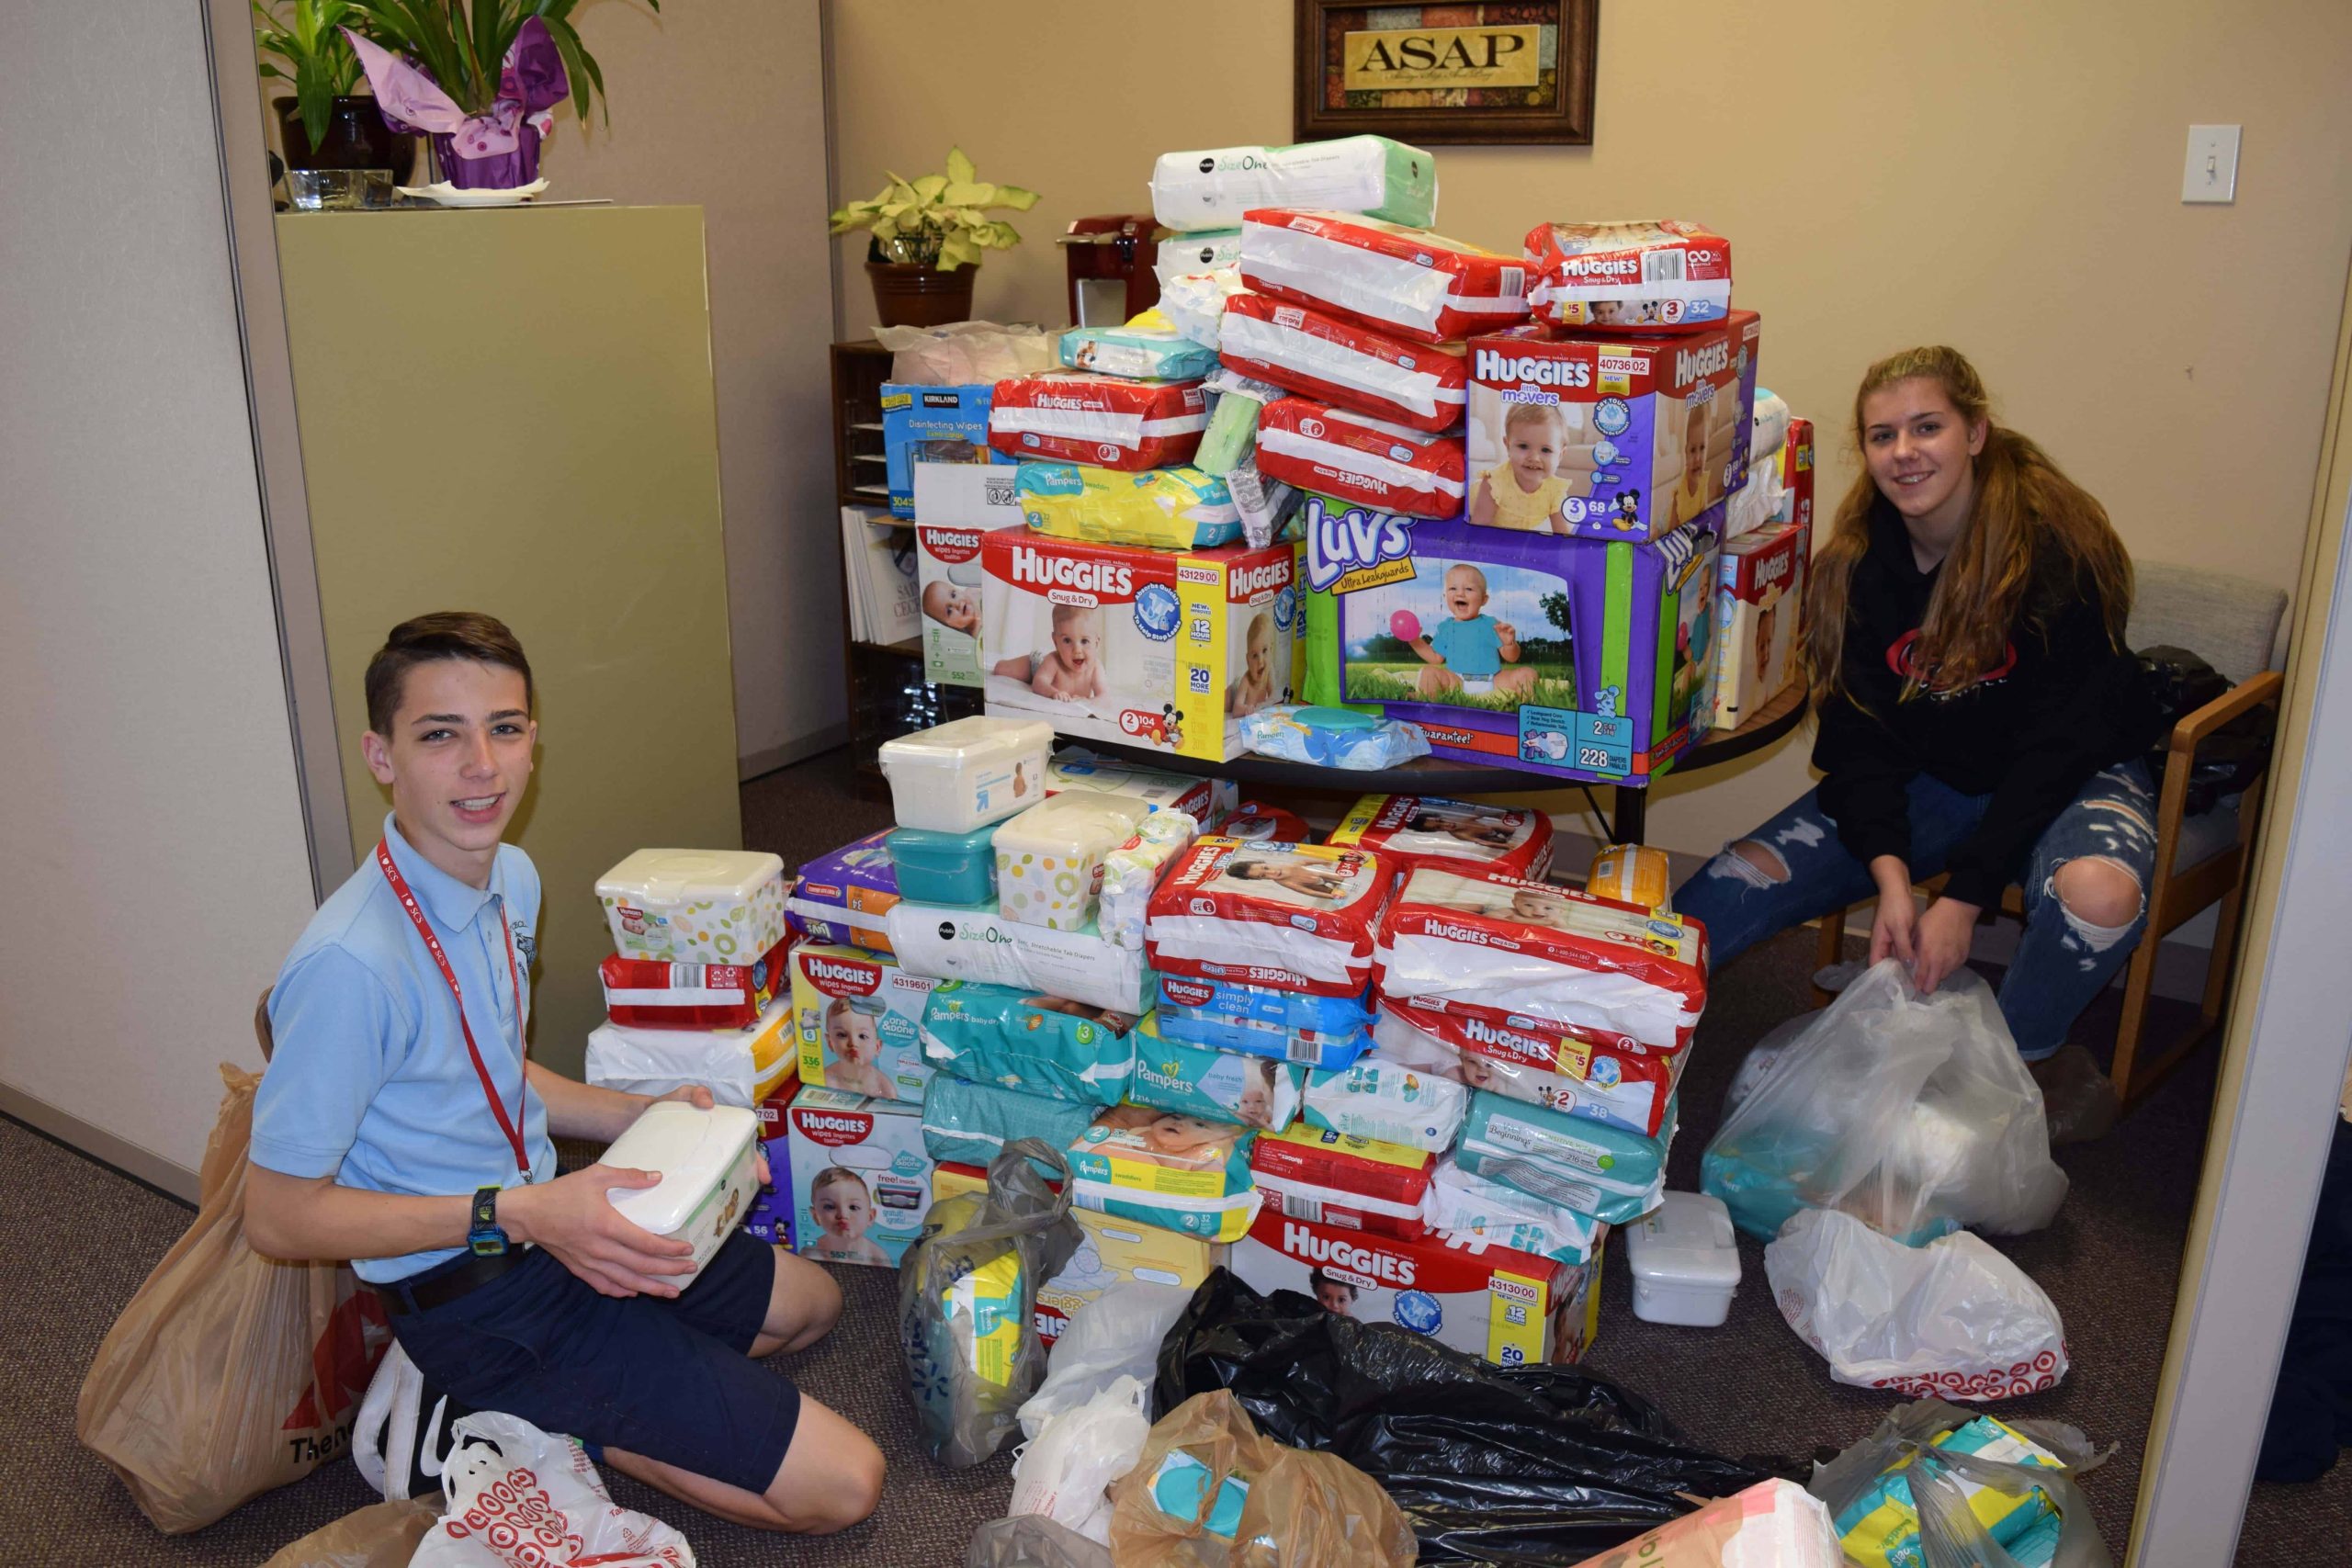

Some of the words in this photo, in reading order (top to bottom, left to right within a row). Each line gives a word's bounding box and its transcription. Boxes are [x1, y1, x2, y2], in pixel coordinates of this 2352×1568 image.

[1357, 33, 1525, 72] ASAP
[1561, 259, 1638, 277] HUGGIES
[1583, 276, 1600, 285] Snug
[1606, 276, 1620, 285] Dry
[1567, 302, 1579, 314] $5
[1666, 301, 1679, 316] 3
[1690, 300, 1710, 314] 32
[1476, 348, 1591, 388] HUGGIES
[1675, 340, 1729, 389] HUGGIES
[1521, 383, 1539, 392] little
[923, 394, 958, 405] KIRKLAND
[1037, 393, 1082, 412] HUGGIES
[1501, 389, 1559, 405] movers
[1596, 398, 1608, 412] DRY
[1608, 397, 1629, 413] TOUCH
[1686, 385, 1715, 409] movers
[909, 420, 954, 431] Disinfecting
[956, 421, 983, 432] Wipes
[1045, 474, 1082, 489] Pampers
[1338, 470, 1388, 494] HUGGIES
[892, 496, 910, 506] 304
[1568, 499, 1580, 514] 3
[1589, 502, 1606, 513] 68
[1031, 512, 1040, 523] 2
[926, 528, 979, 547] HUGGIES
[1208, 527, 1216, 538] 2
[934, 545, 951, 555] wipes
[1012, 545, 1134, 597] HUGGIES
[1229, 559, 1290, 599] HUGGIES
[1340, 576, 1361, 589] Ultra
[1361, 561, 1409, 583] Leakguards
[1754, 551, 1790, 591] HUGGIES
[1051, 592, 1070, 604] Snug
[1071, 594, 1078, 603] &
[1078, 595, 1093, 607] Dry
[1135, 582, 1159, 601] Absorbs
[1159, 583, 1181, 606] Quickly
[1133, 614, 1141, 625] To
[1138, 622, 1153, 640] Help
[1151, 632, 1168, 641] Stop
[1167, 620, 1182, 638] Leaks
[1193, 618, 1211, 633] 12
[1190, 631, 1211, 639] HOUR
[951, 671, 966, 681] 552
[1190, 668, 1210, 683] 20
[1190, 682, 1209, 690] MORE
[1126, 713, 1134, 725] 2
[1137, 715, 1156, 728] 104
[1593, 720, 1603, 736] 2
[1579, 747, 1609, 768] 228
[1375, 796, 1415, 829] HUGGIES
[385, 864, 399, 883] SCS
[1172, 845, 1223, 886] HUGGIES
[1487, 873, 1599, 901] HUGGIES
[410, 907, 424, 924] SCS
[1424, 919, 1488, 945] HUGGIES
[435, 949, 447, 967] SCS
[1063, 948, 1073, 957] Tab
[1074, 951, 1096, 962] Diapers
[808, 957, 876, 986] HUGGIES
[1250, 966, 1308, 987] HUGGIES
[820, 979, 840, 988] wipes
[1168, 981, 1210, 998] HUGGIES
[1216, 989, 1255, 1007] simply
[1412, 995, 1441, 1007] HUGGIES
[1218, 1000, 1250, 1014] clean
[889, 1017, 908, 1026] one
[931, 1007, 970, 1022] Pampers
[971, 1015, 987, 1027] baby
[1081, 1024, 1090, 1039] 3
[1465, 1018, 1552, 1062] HUGGIES
[1623, 1040, 1631, 1048] 2
[802, 1055, 821, 1067] 336
[1487, 1044, 1507, 1058] Snug
[1512, 1051, 1528, 1063] Dry
[1575, 1055, 1587, 1066] $5
[1136, 1058, 1193, 1094] Pampers
[1208, 1072, 1225, 1081] baby
[1227, 1074, 1244, 1083] fresh
[1557, 1091, 1570, 1106] 2
[1589, 1103, 1609, 1119] 38
[801, 1111, 867, 1134] HUGGIES
[812, 1130, 832, 1139] wipes
[1091, 1127, 1103, 1138] 2
[1488, 1124, 1533, 1148] Beginnings
[1566, 1153, 1581, 1164] 216
[1080, 1160, 1109, 1176] Pampers
[877, 1174, 899, 1185] free!
[1185, 1215, 1194, 1227] 2
[753, 1225, 768, 1235] 56
[1283, 1221, 1416, 1286] HUGGIES
[1326, 1268, 1347, 1282] Snug
[1347, 1274, 1355, 1282] &
[1355, 1276, 1373, 1288] Dry
[1396, 1288, 1420, 1301] Absorbs
[1420, 1291, 1442, 1312] Quickly
[1508, 1304, 1527, 1317] 12
[1505, 1314, 1527, 1325] HOUR
[1500, 1346, 1524, 1362] 20
